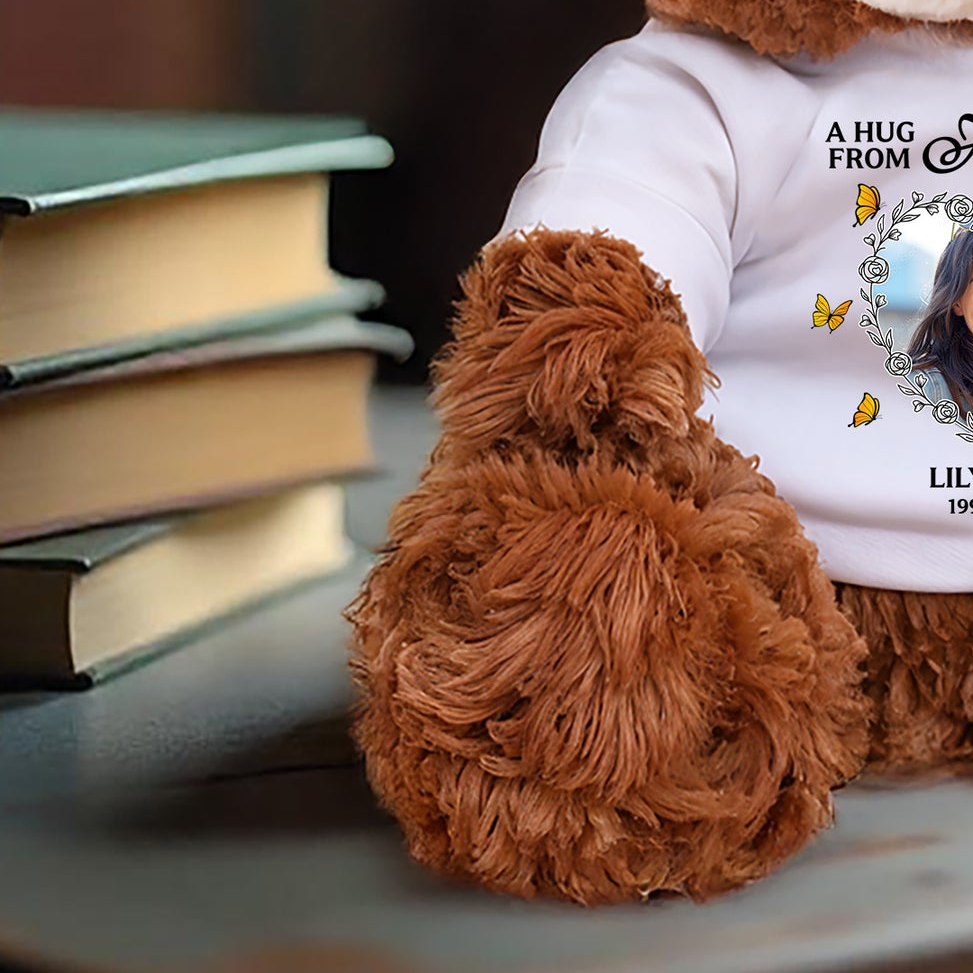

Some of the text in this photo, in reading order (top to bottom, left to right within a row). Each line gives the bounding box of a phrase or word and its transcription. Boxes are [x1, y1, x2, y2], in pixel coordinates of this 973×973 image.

[825, 121, 915, 143] A HUG
[828, 147, 911, 170] FROM
